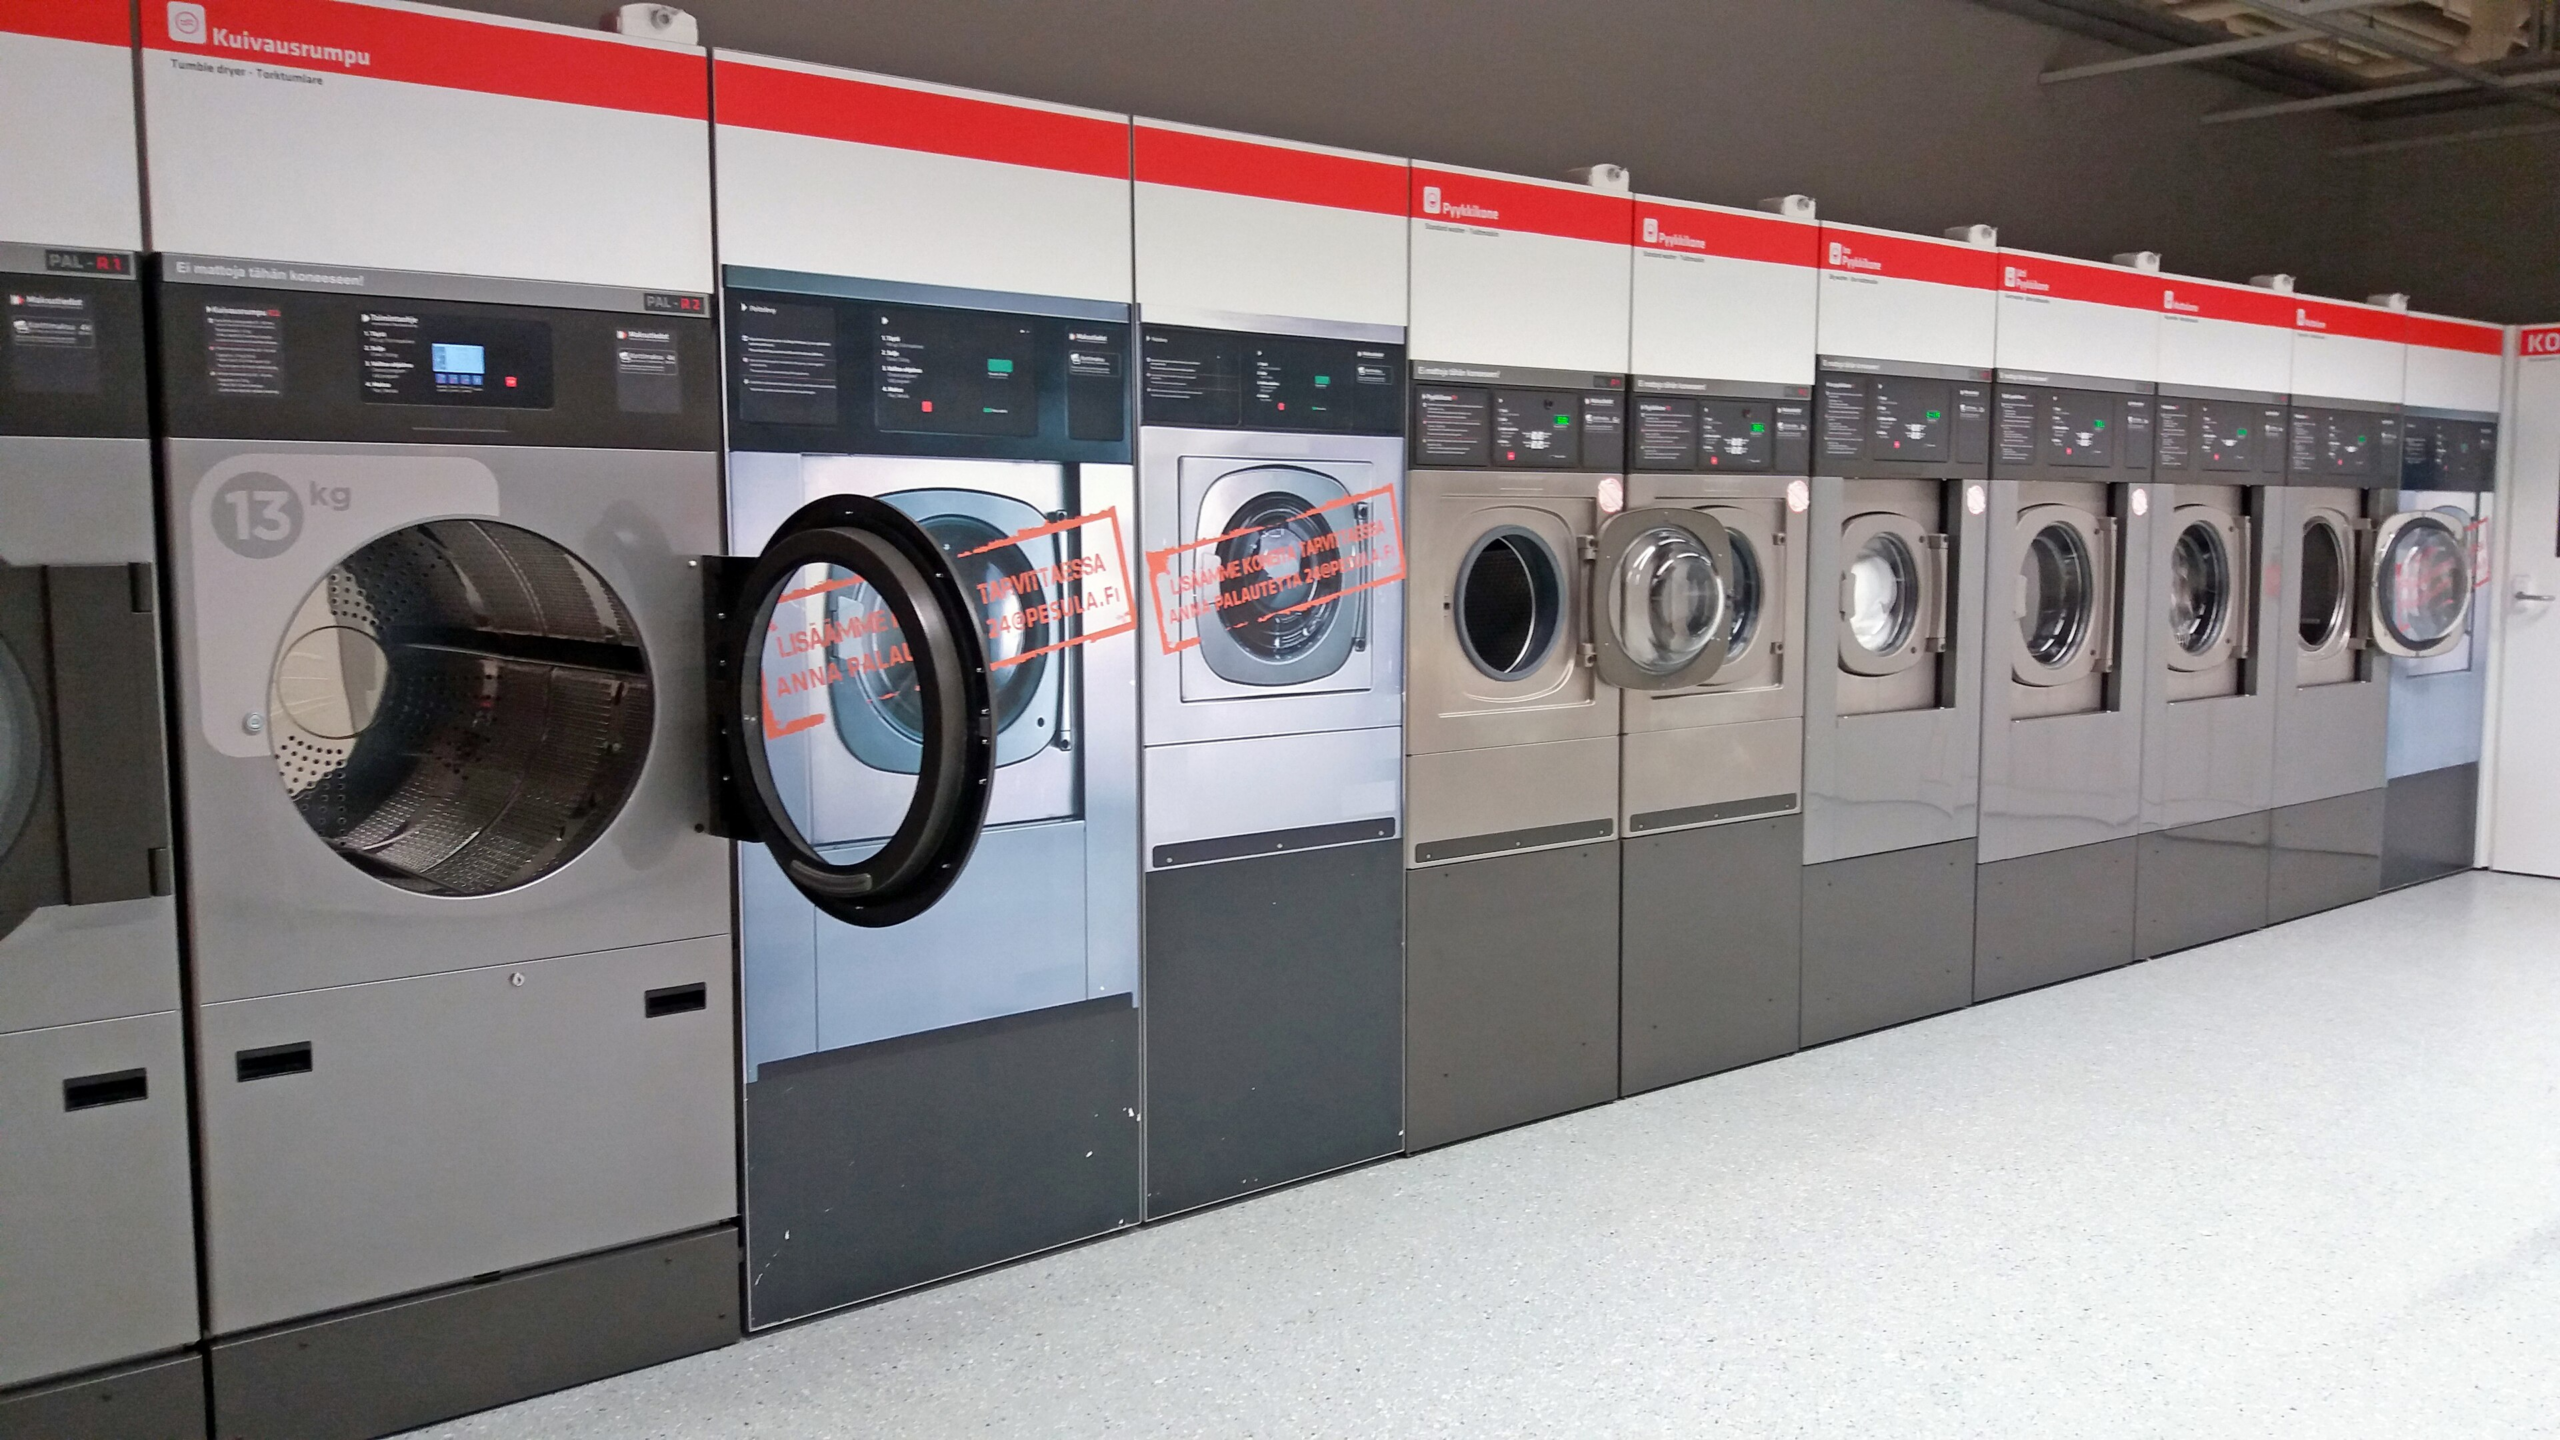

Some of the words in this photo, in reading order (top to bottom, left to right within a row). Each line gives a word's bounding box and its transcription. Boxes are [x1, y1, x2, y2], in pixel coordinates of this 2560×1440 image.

[213, 27, 371, 67] Kuivausrumpu
[170, 58, 214, 74] Tumble
[216, 63, 246, 78] dryer
[256, 68, 323, 85] Torktumlare
[175, 261, 191, 274] Ei
[193, 264, 246, 279] mattoja
[248, 267, 287, 280] tähän
[289, 269, 365, 287] koneeseen!
[225, 490, 291, 541] 13
[309, 480, 352, 511] kg
[976, 553, 1107, 605] TARVITTAESSA
[1170, 560, 1242, 595] LISÄÄMME
[1169, 598, 1211, 624] ANNA
[1214, 573, 1303, 612] PALAUTETTA
[776, 609, 889, 658] LISÄÄMME
[776, 662, 843, 698] ANNA
